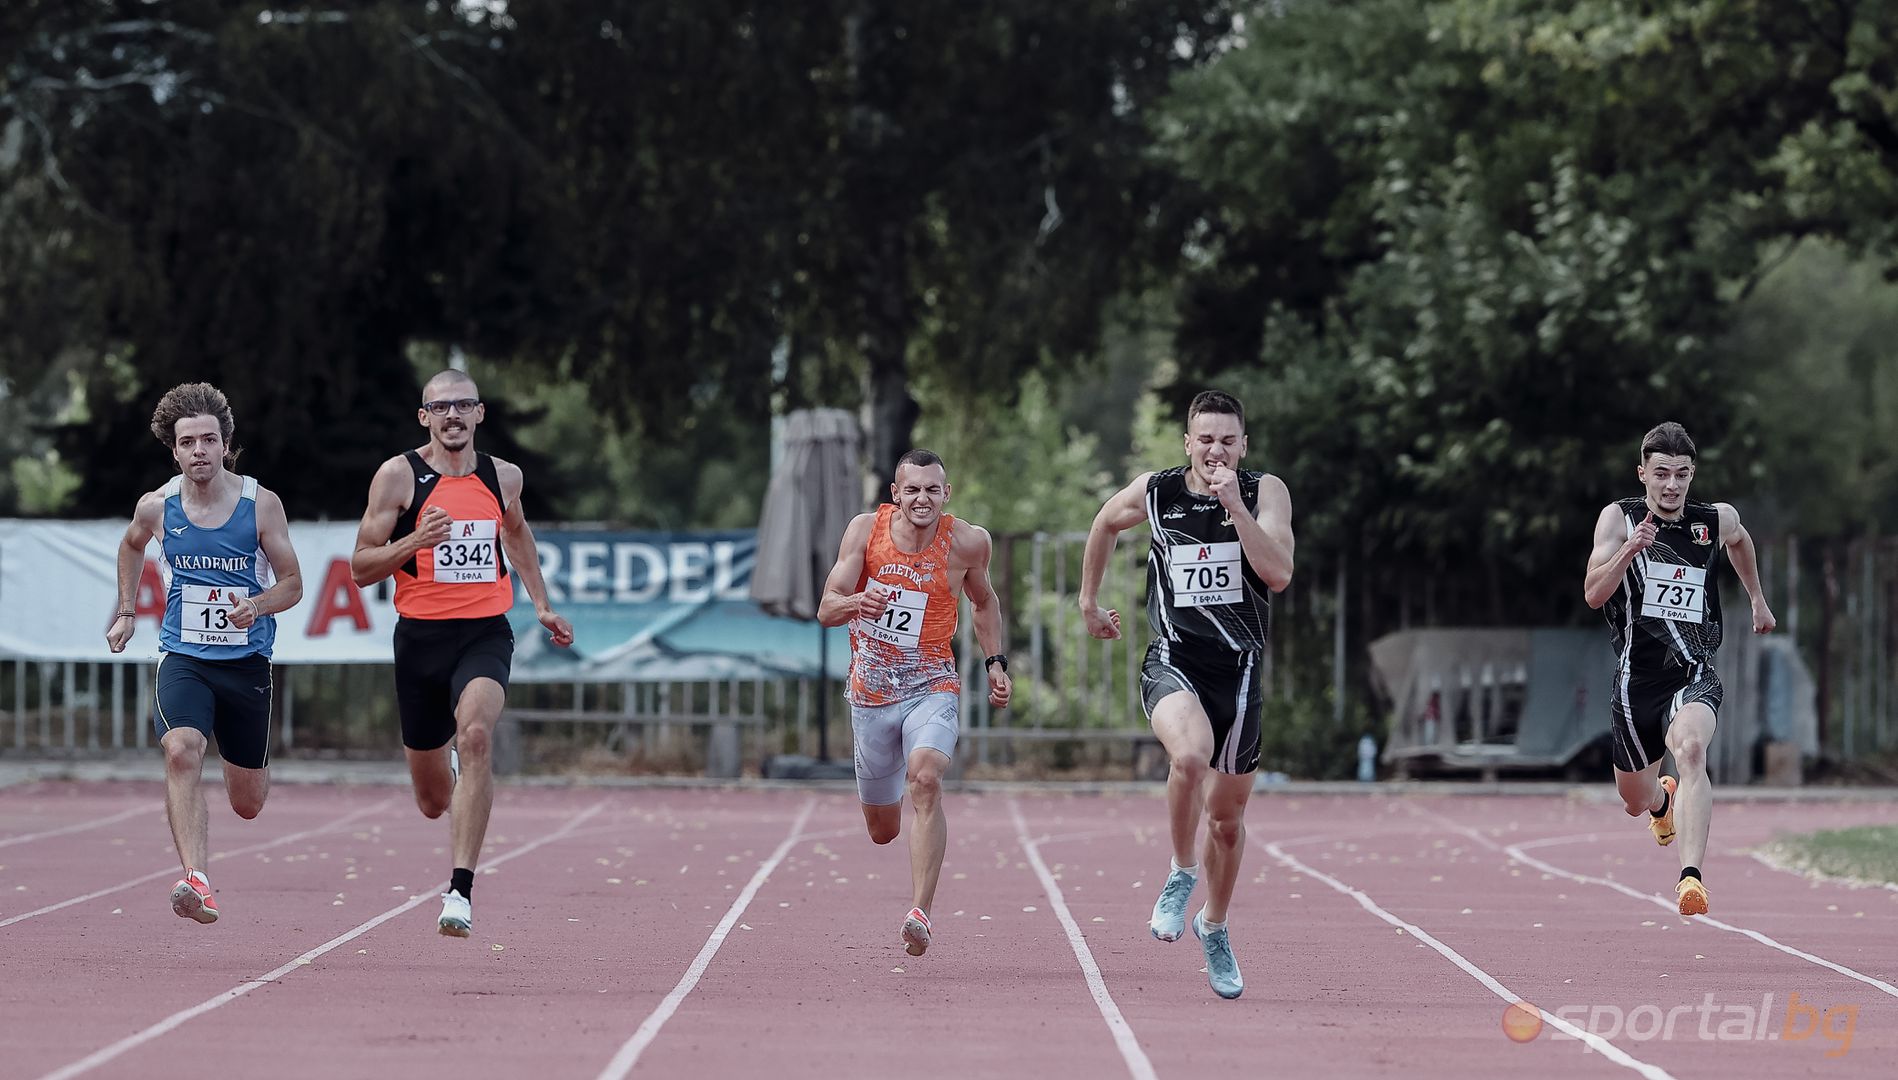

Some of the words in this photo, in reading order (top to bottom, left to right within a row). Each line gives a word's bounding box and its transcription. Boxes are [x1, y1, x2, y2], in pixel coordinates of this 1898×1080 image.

[462, 522, 475, 537] A1
[439, 543, 493, 567] 3342
[1197, 545, 1212, 560] A1
[174, 554, 249, 573] AKADEMIK
[462, 572, 483, 581] БФЛА
[1183, 566, 1230, 590] 705
[1672, 567, 1686, 580] A1
[207, 588, 222, 602] A1
[887, 590, 902, 603] A1
[1199, 595, 1223, 604] БФЛА
[1656, 584, 1696, 608] 737
[200, 608, 229, 630] 13
[874, 608, 912, 632] 12
[1667, 611, 1688, 620] БФЛА
[205, 635, 229, 644] БФЛА
[879, 632, 900, 644] БФЛА
